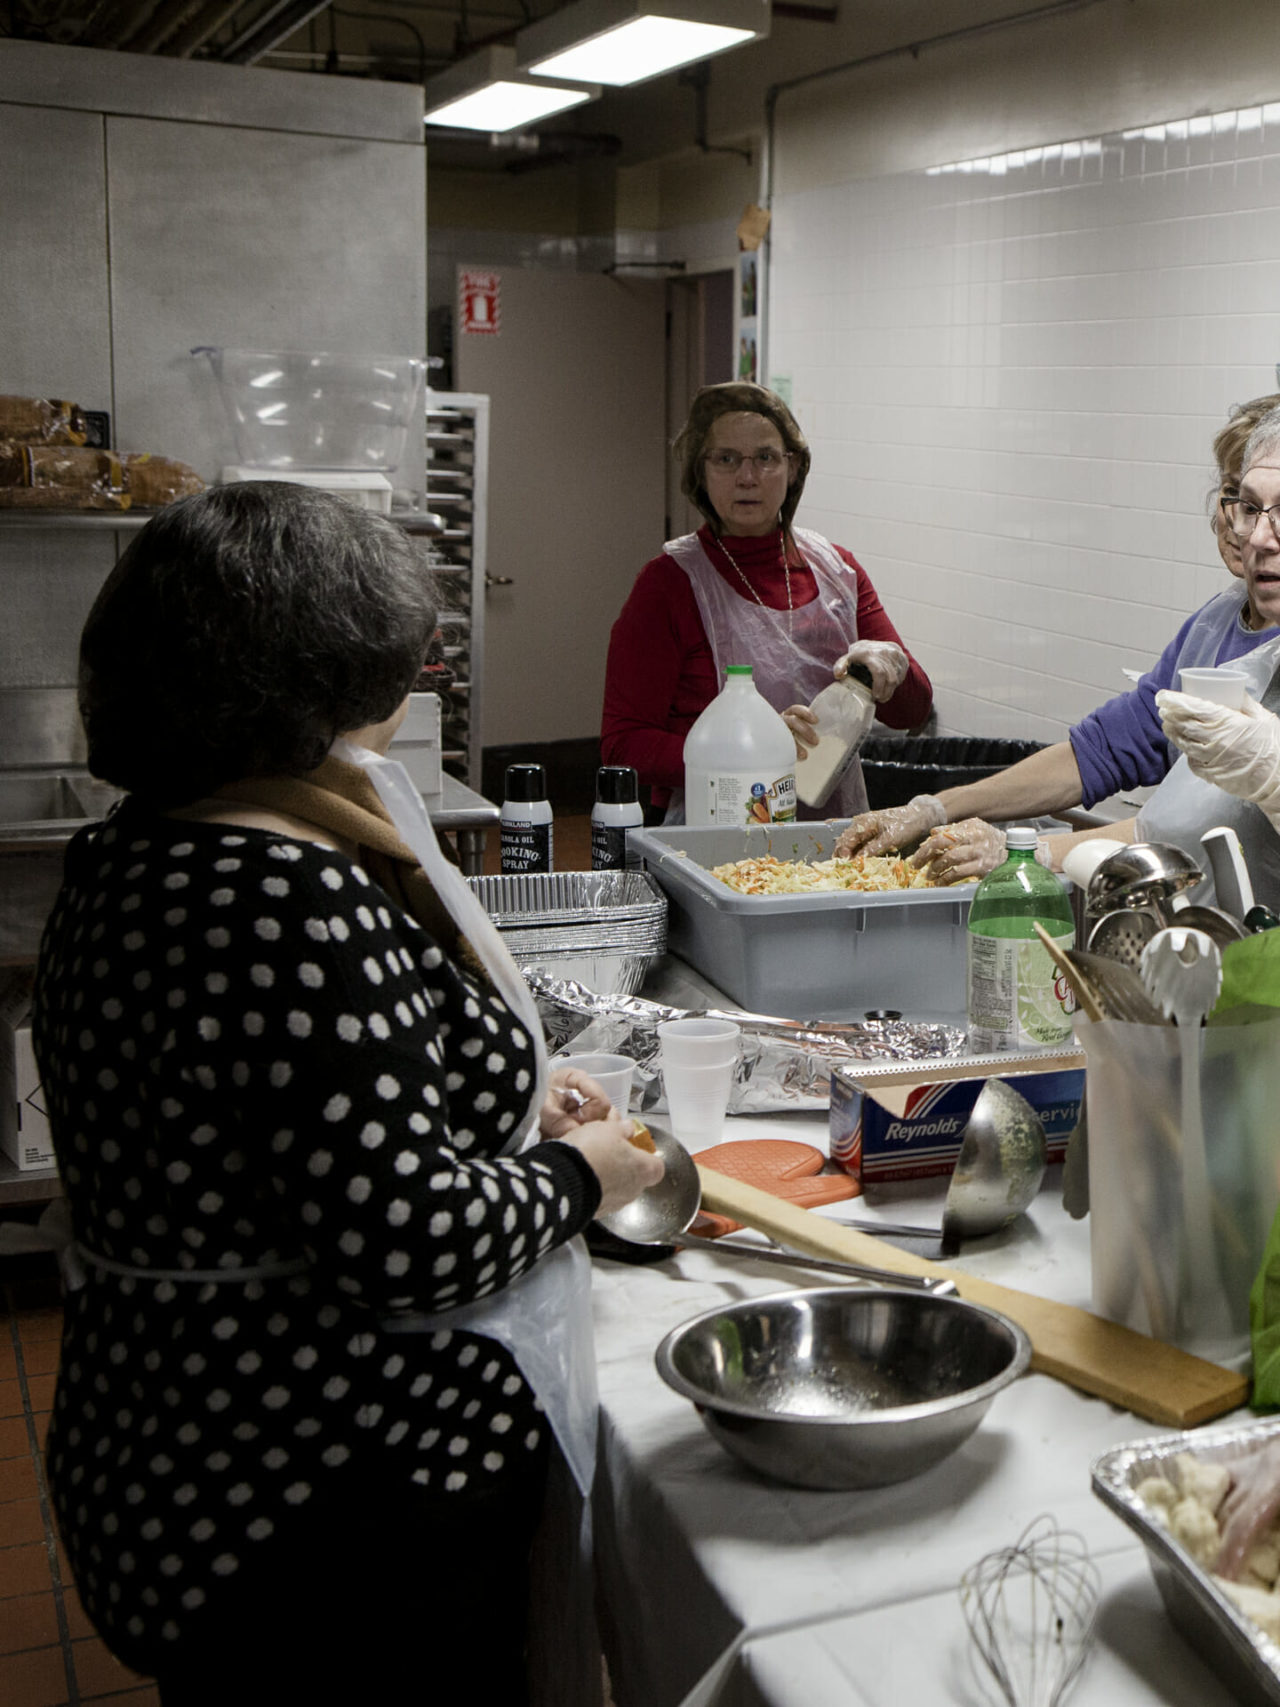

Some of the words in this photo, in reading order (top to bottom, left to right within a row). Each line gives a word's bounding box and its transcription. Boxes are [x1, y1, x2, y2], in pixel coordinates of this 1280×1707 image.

[521, 835, 535, 845] OIL
[500, 846, 540, 862] OOKING
[502, 858, 529, 869] SPRAY
[1031, 1102, 1078, 1122] servi
[884, 1117, 958, 1143] Reynolds
